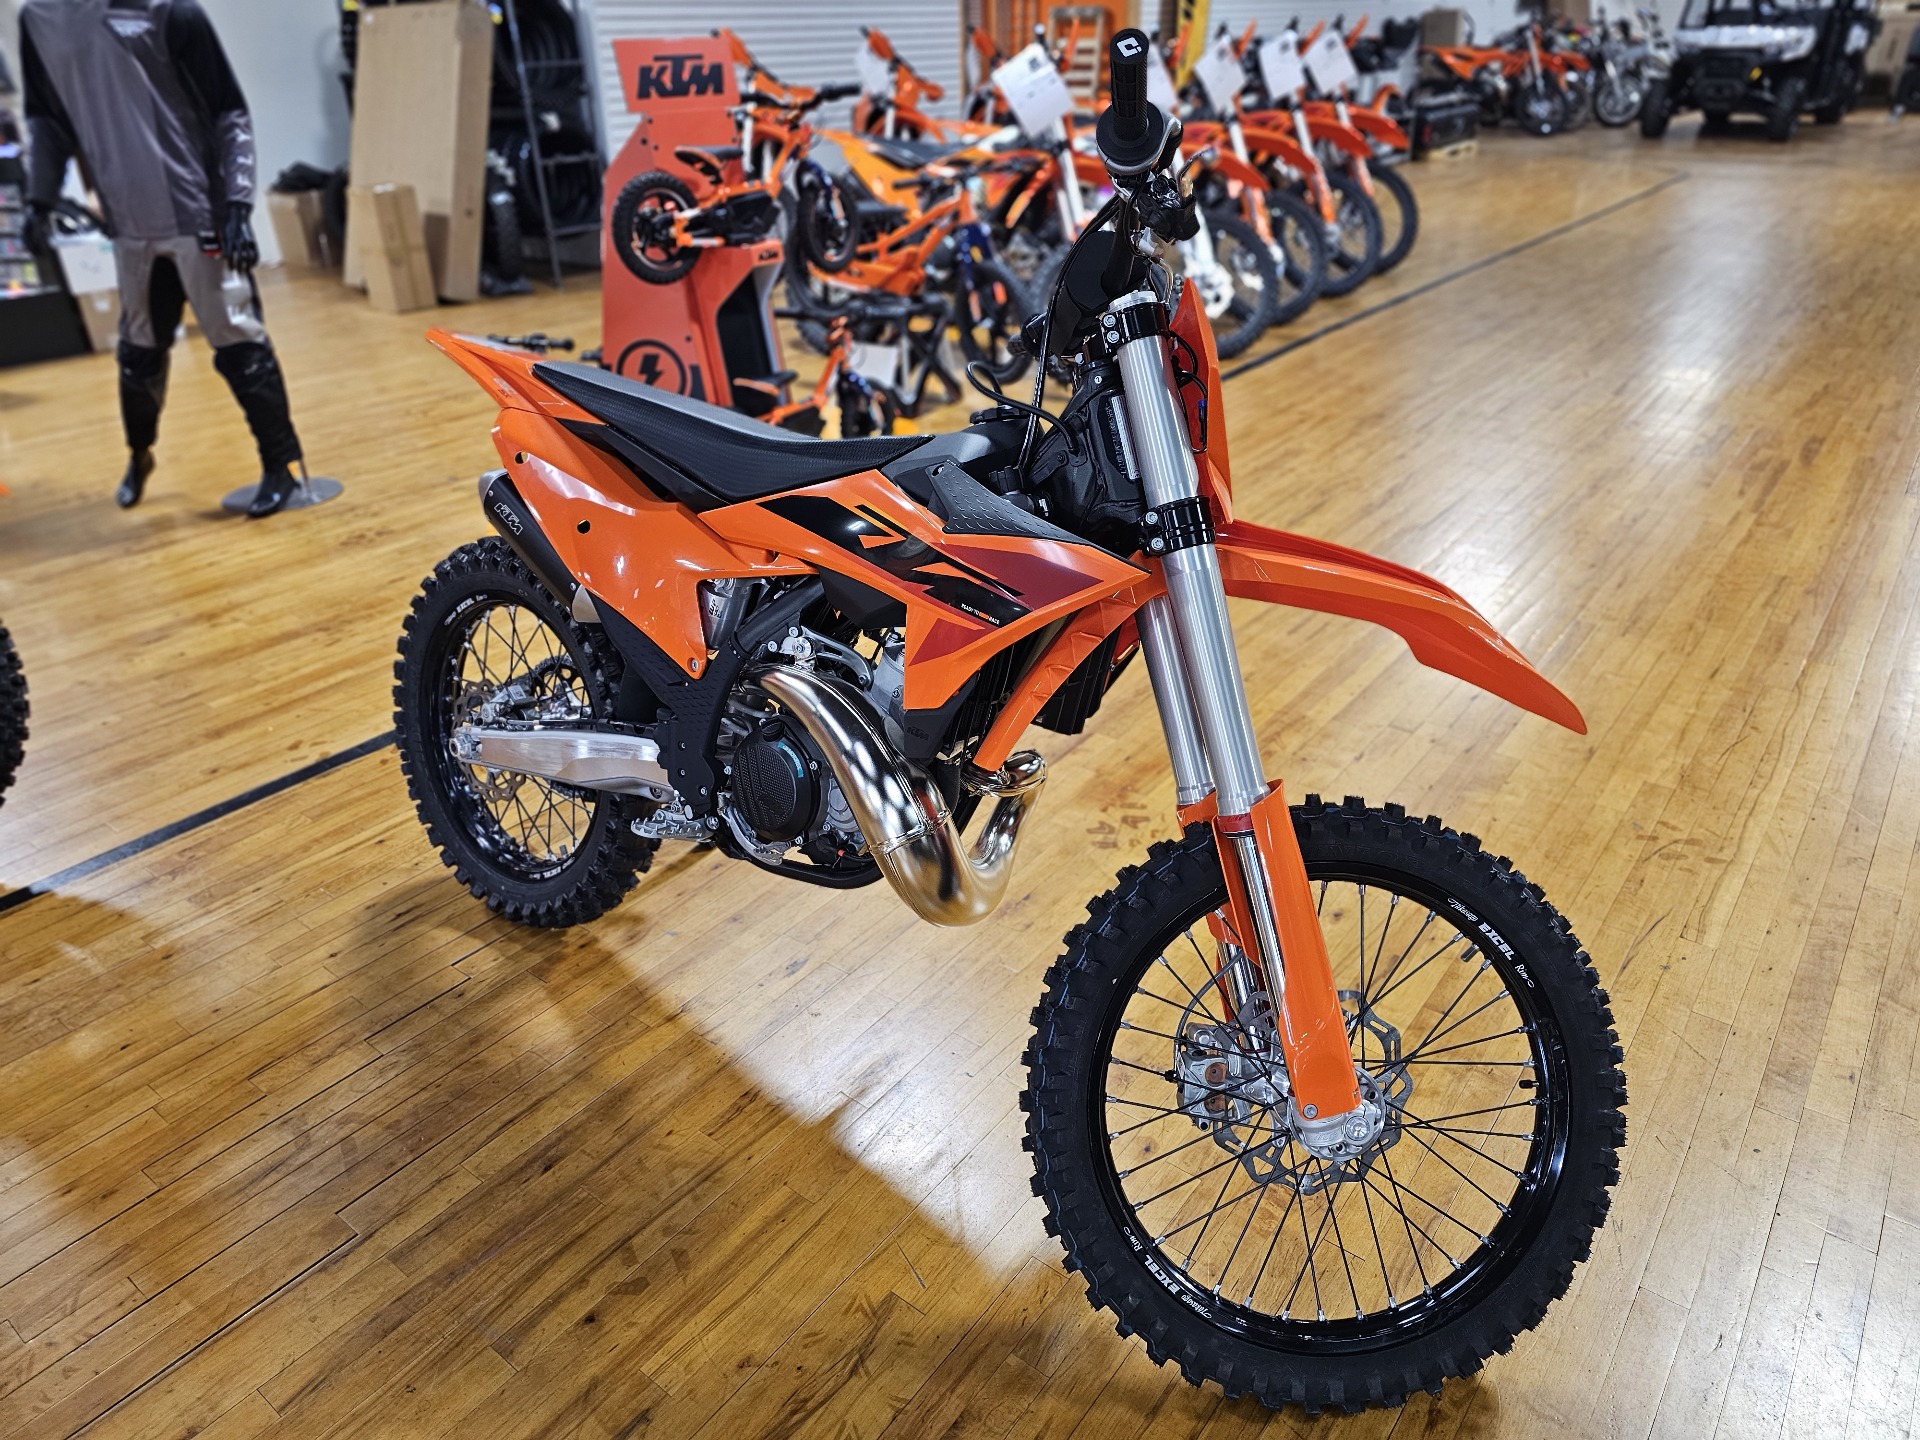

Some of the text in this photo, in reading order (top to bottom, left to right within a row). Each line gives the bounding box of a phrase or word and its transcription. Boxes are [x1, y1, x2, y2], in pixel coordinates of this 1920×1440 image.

[637, 54, 724, 99] KTM
[494, 502, 523, 535] KTM
[1478, 922, 1514, 961] EXCEL
[1515, 964, 1533, 986] Rim
[1126, 1230, 1143, 1252] Rim
[1144, 1254, 1180, 1295] EXCEL
